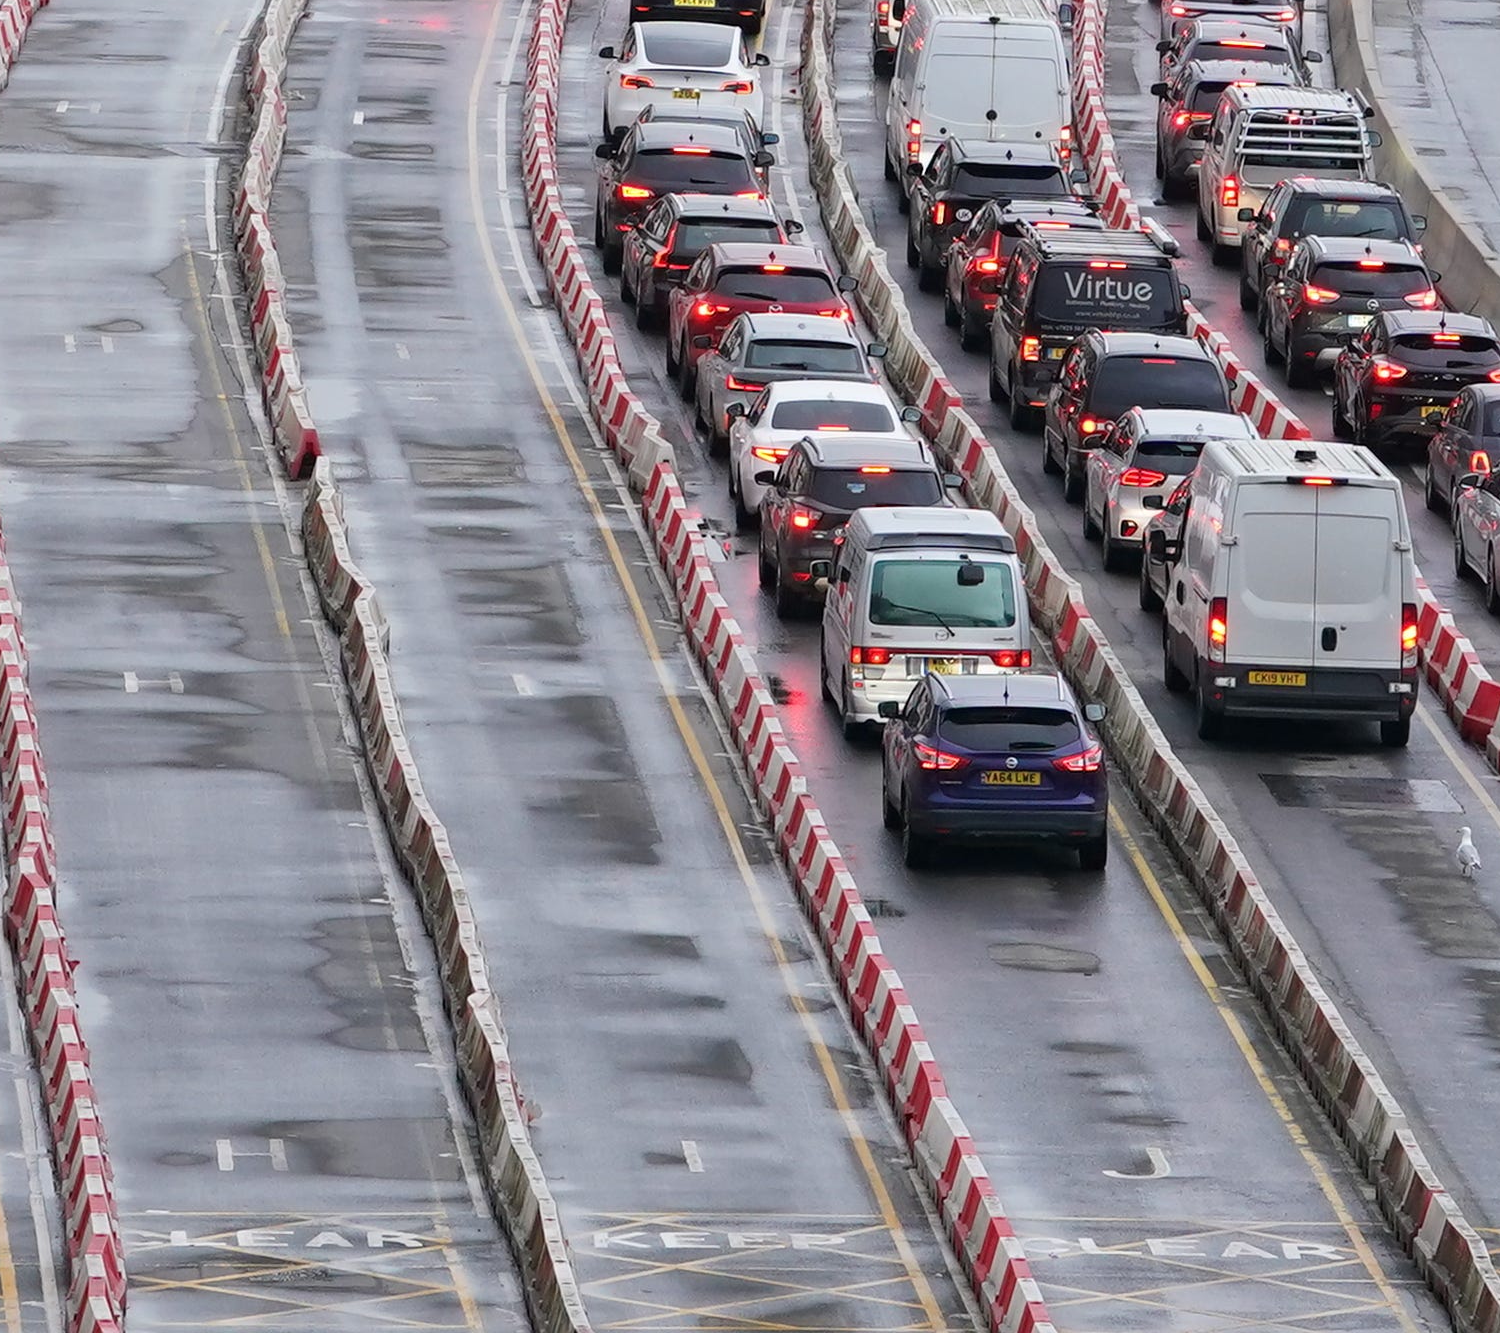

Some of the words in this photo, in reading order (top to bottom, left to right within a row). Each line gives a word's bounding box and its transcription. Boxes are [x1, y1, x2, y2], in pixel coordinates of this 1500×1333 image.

[1065, 272, 1153, 301] Virtue
[1254, 672, 1277, 682] CK19
[1280, 673, 1300, 683] VHT
[985, 771, 1013, 782] YA64
[1014, 773, 1037, 783] LWE
[215, 1138, 289, 1171] H
[1101, 1146, 1172, 1180] J
[122, 1228, 426, 1250] CLEAR
[592, 1228, 850, 1250] KEEP
[1016, 1234, 1348, 1262] CLEAR
